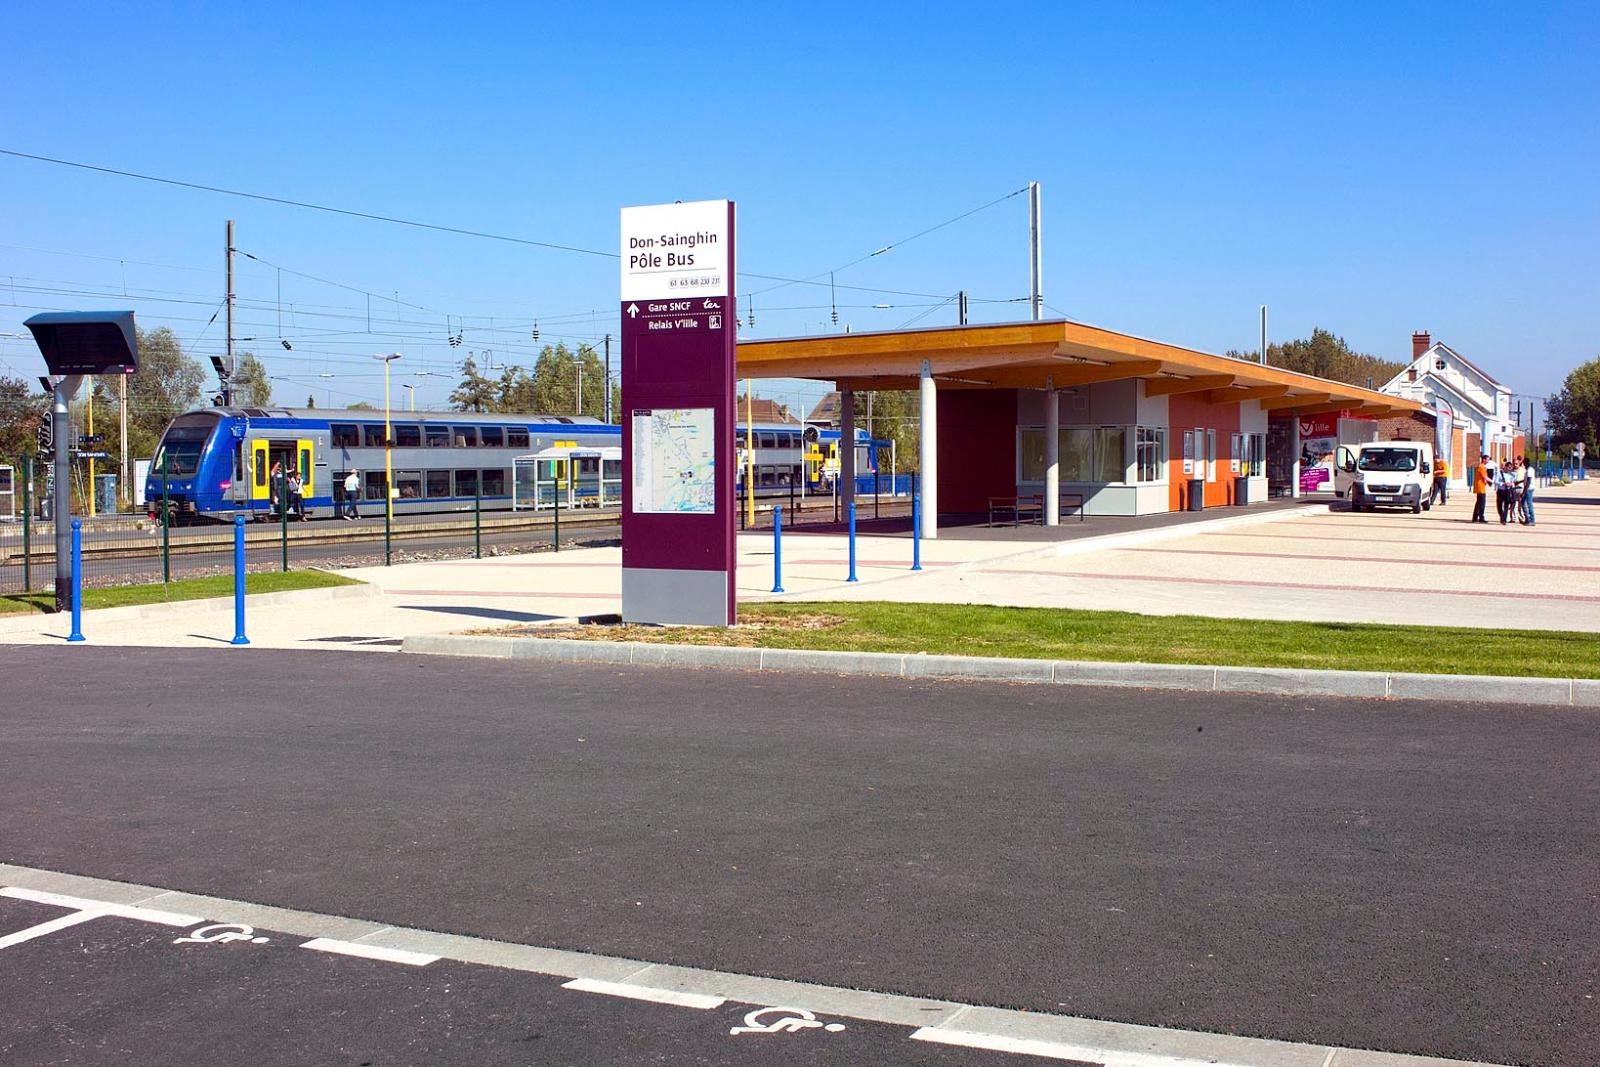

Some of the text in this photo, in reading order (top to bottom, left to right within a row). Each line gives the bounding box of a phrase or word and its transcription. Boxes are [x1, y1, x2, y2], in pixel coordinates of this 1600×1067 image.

[630, 231, 717, 248] Don-Sainghin
[630, 252, 694, 269] Pôle Bus
[648, 301, 691, 312] Gare SNCF
[648, 320, 673, 330] Relais
